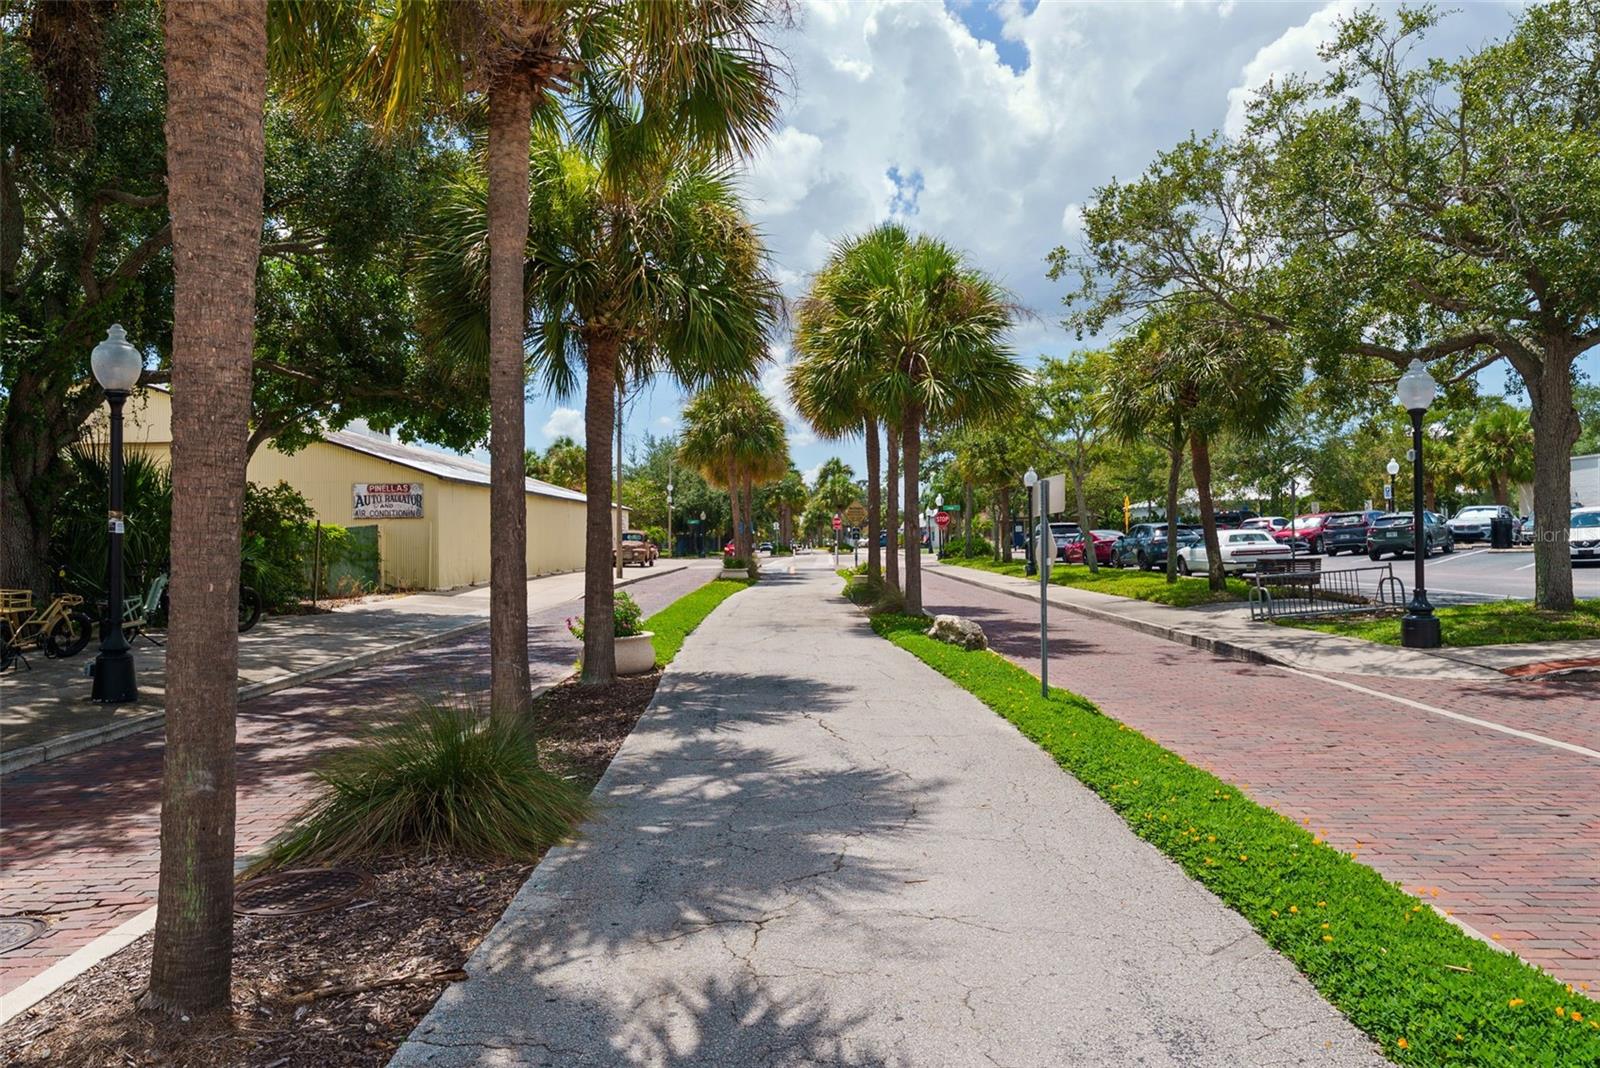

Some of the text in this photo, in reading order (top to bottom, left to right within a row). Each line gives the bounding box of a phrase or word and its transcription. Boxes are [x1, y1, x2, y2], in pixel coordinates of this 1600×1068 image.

[369, 484, 408, 492] PINELLAS
[355, 494, 422, 508] AUTO RADIATOR
[369, 509, 421, 517] CONDITIONING
